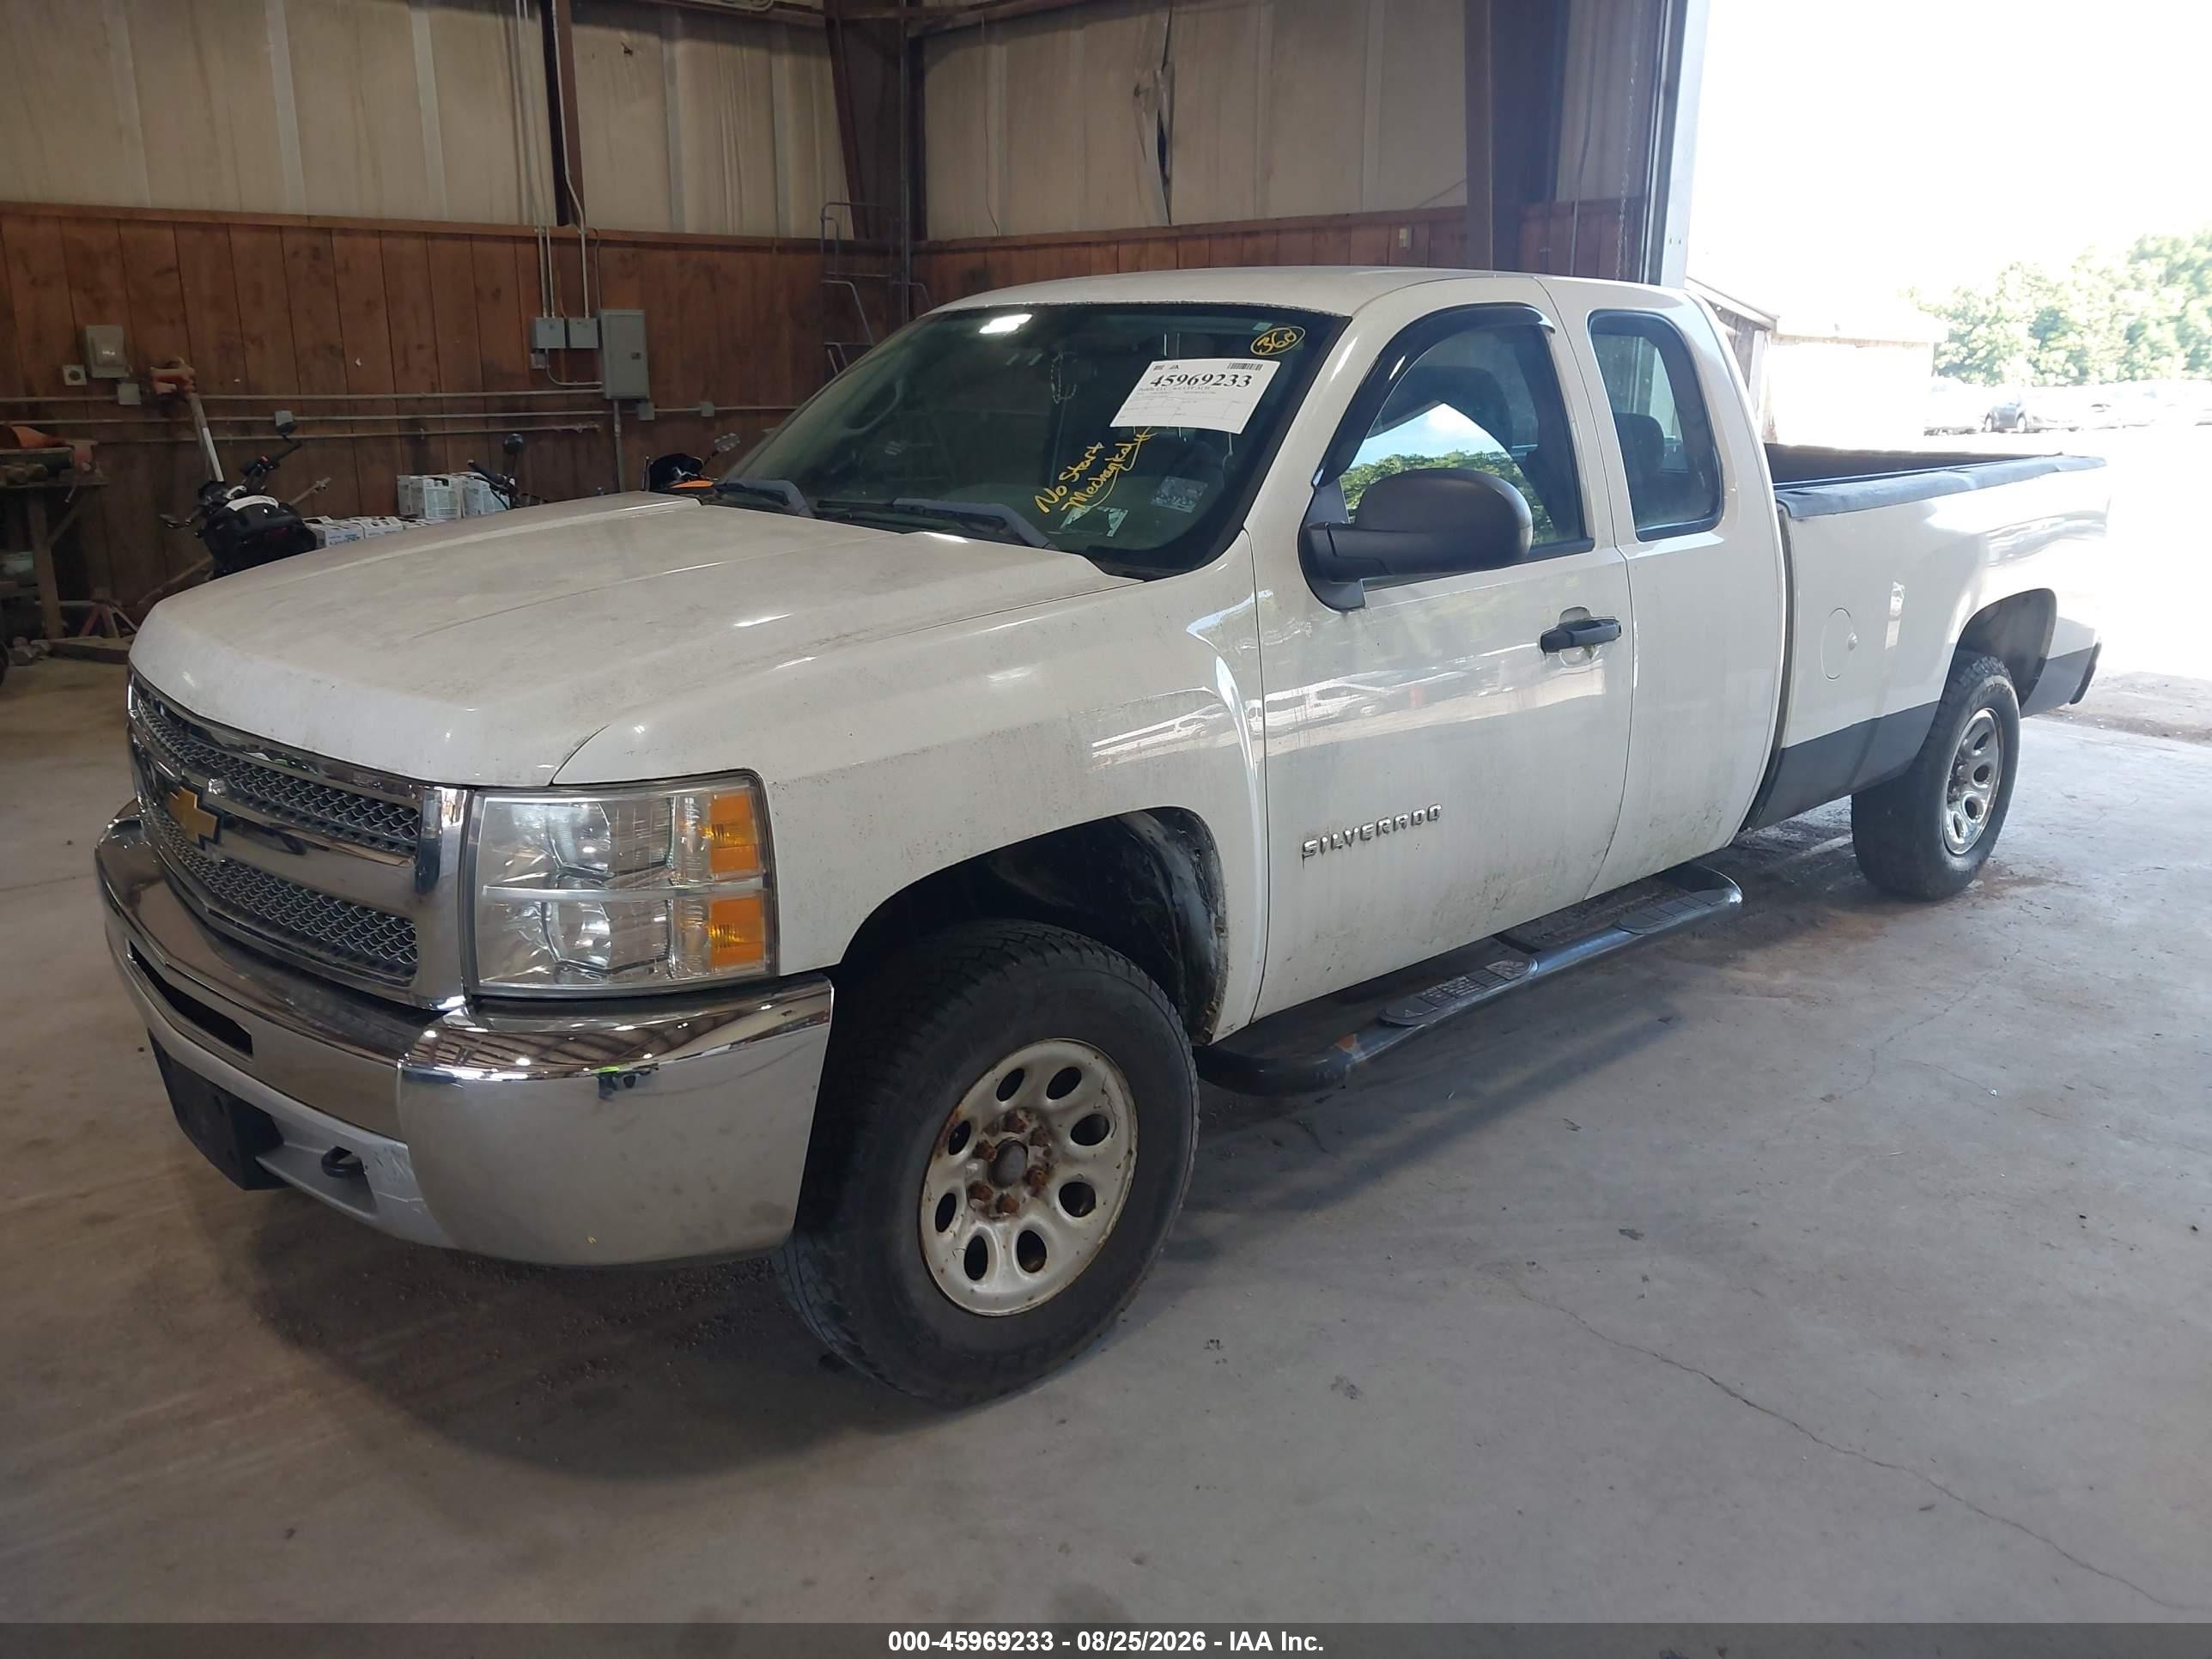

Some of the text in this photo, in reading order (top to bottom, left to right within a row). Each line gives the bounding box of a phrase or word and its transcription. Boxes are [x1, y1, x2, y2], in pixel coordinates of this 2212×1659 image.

[1150, 373, 1253, 388] 45969233
[1034, 441, 1105, 514] No Start
[1302, 804, 1443, 859] SILVERADO
